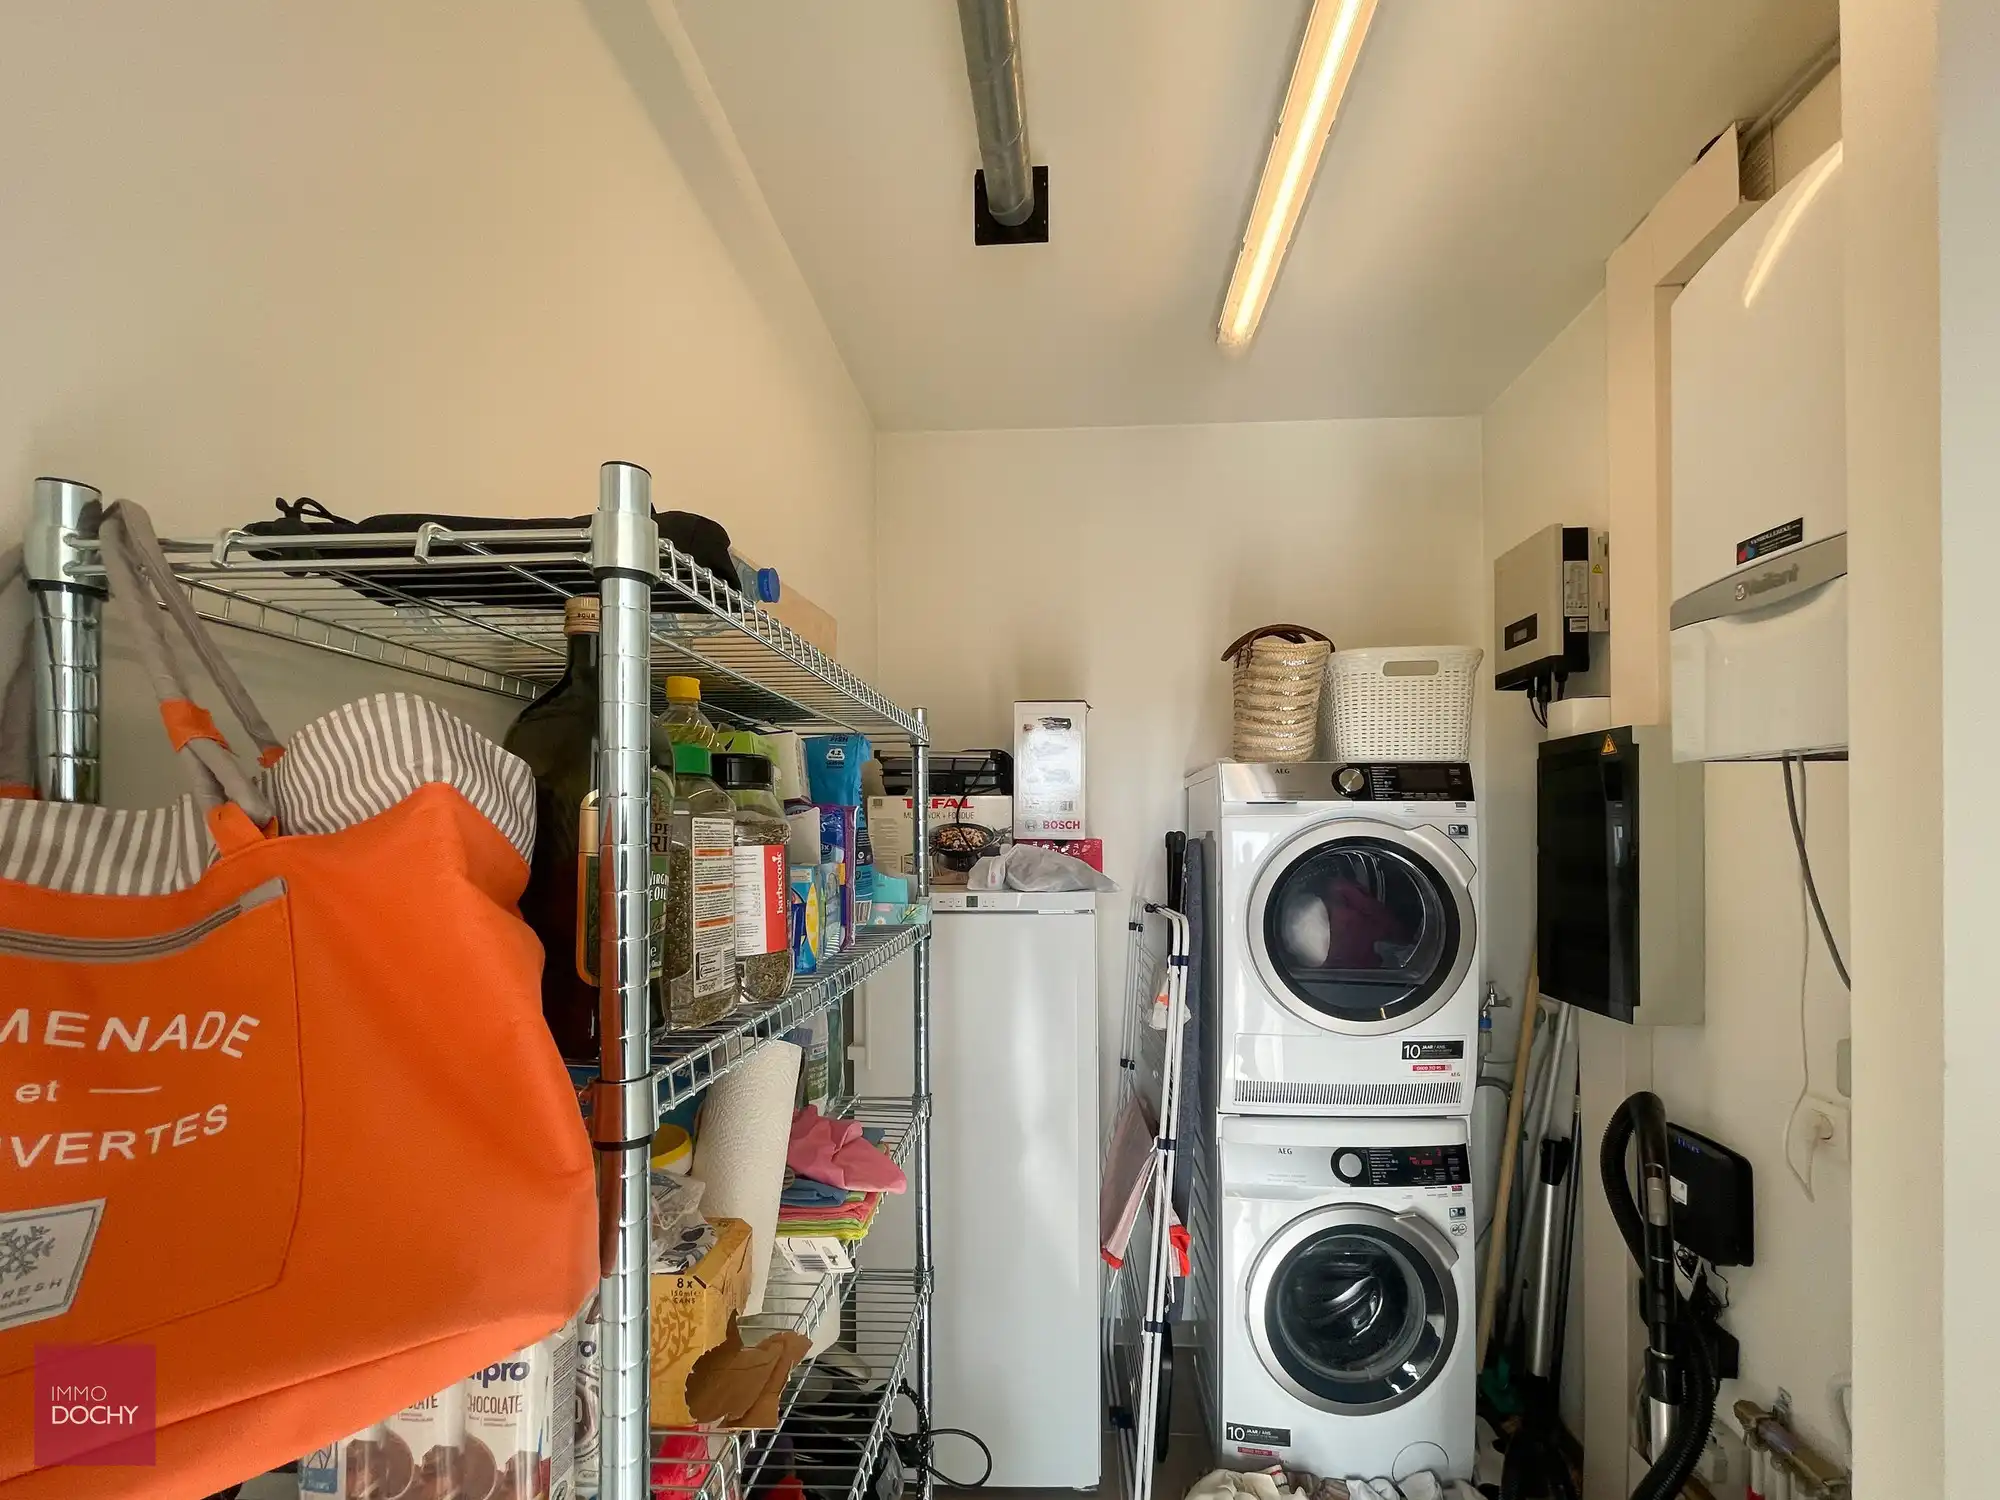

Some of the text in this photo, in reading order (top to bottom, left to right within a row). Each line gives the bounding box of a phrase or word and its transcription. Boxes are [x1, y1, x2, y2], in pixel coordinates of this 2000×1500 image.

[902, 798, 975, 809] TFAL
[1043, 820, 1080, 830] BOSCH
[773, 852, 785, 914] barbecook
[1403, 1044, 1421, 1059] 10
[15, 1080, 60, 1103] et
[677, 1278, 693, 1289] 8 x
[468, 1361, 530, 1389] pro
[1227, 1426, 1245, 1441] 10
